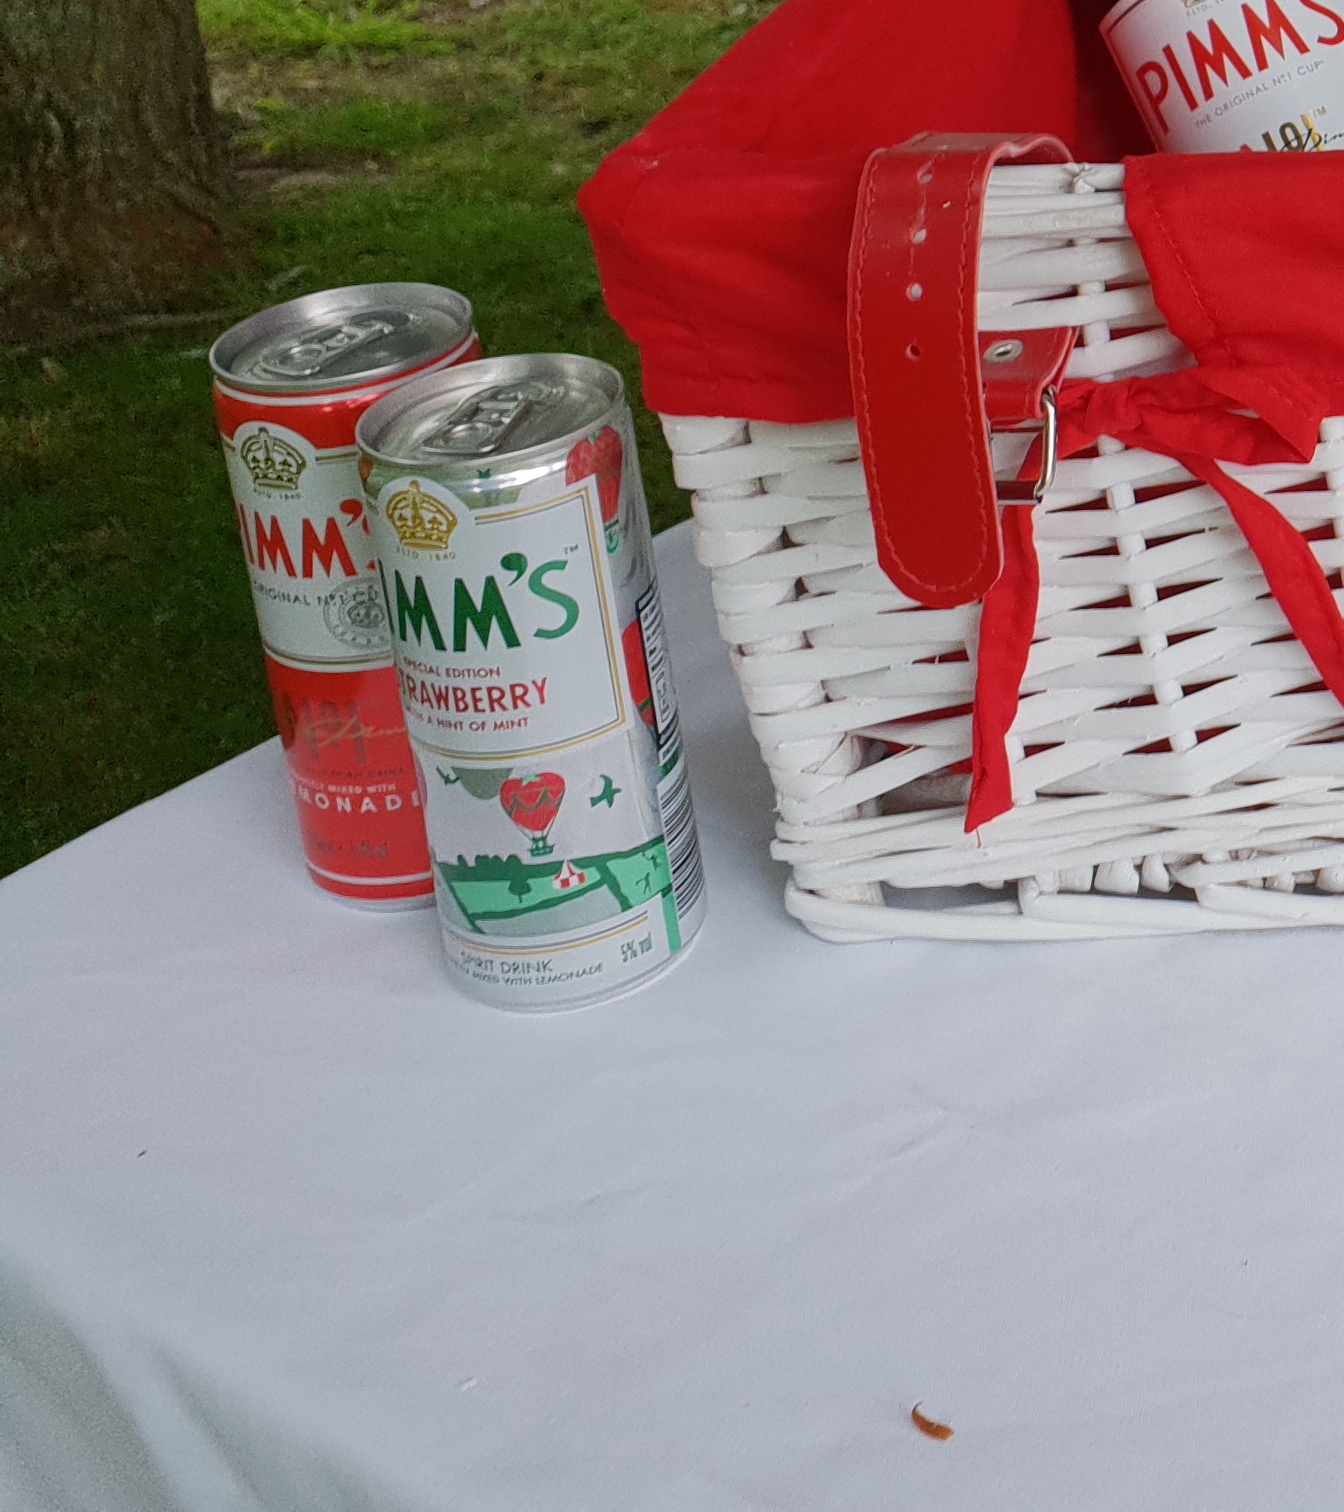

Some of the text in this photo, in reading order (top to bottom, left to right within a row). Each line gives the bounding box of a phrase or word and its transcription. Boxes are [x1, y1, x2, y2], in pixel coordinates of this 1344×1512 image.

[1195, 114, 1212, 129] THE
[1214, 82, 1270, 118] ORIGINAL
[1296, 60, 1324, 78] CUP
[376, 551, 580, 653] IMM'S
[445, 666, 501, 679] EDITION
[399, 668, 548, 714] TRAWBERRY
[469, 718, 487, 732] OF
[492, 716, 530, 731] MINT
[499, 958, 553, 976] DRINK
[534, 963, 604, 986] LEMONADE
